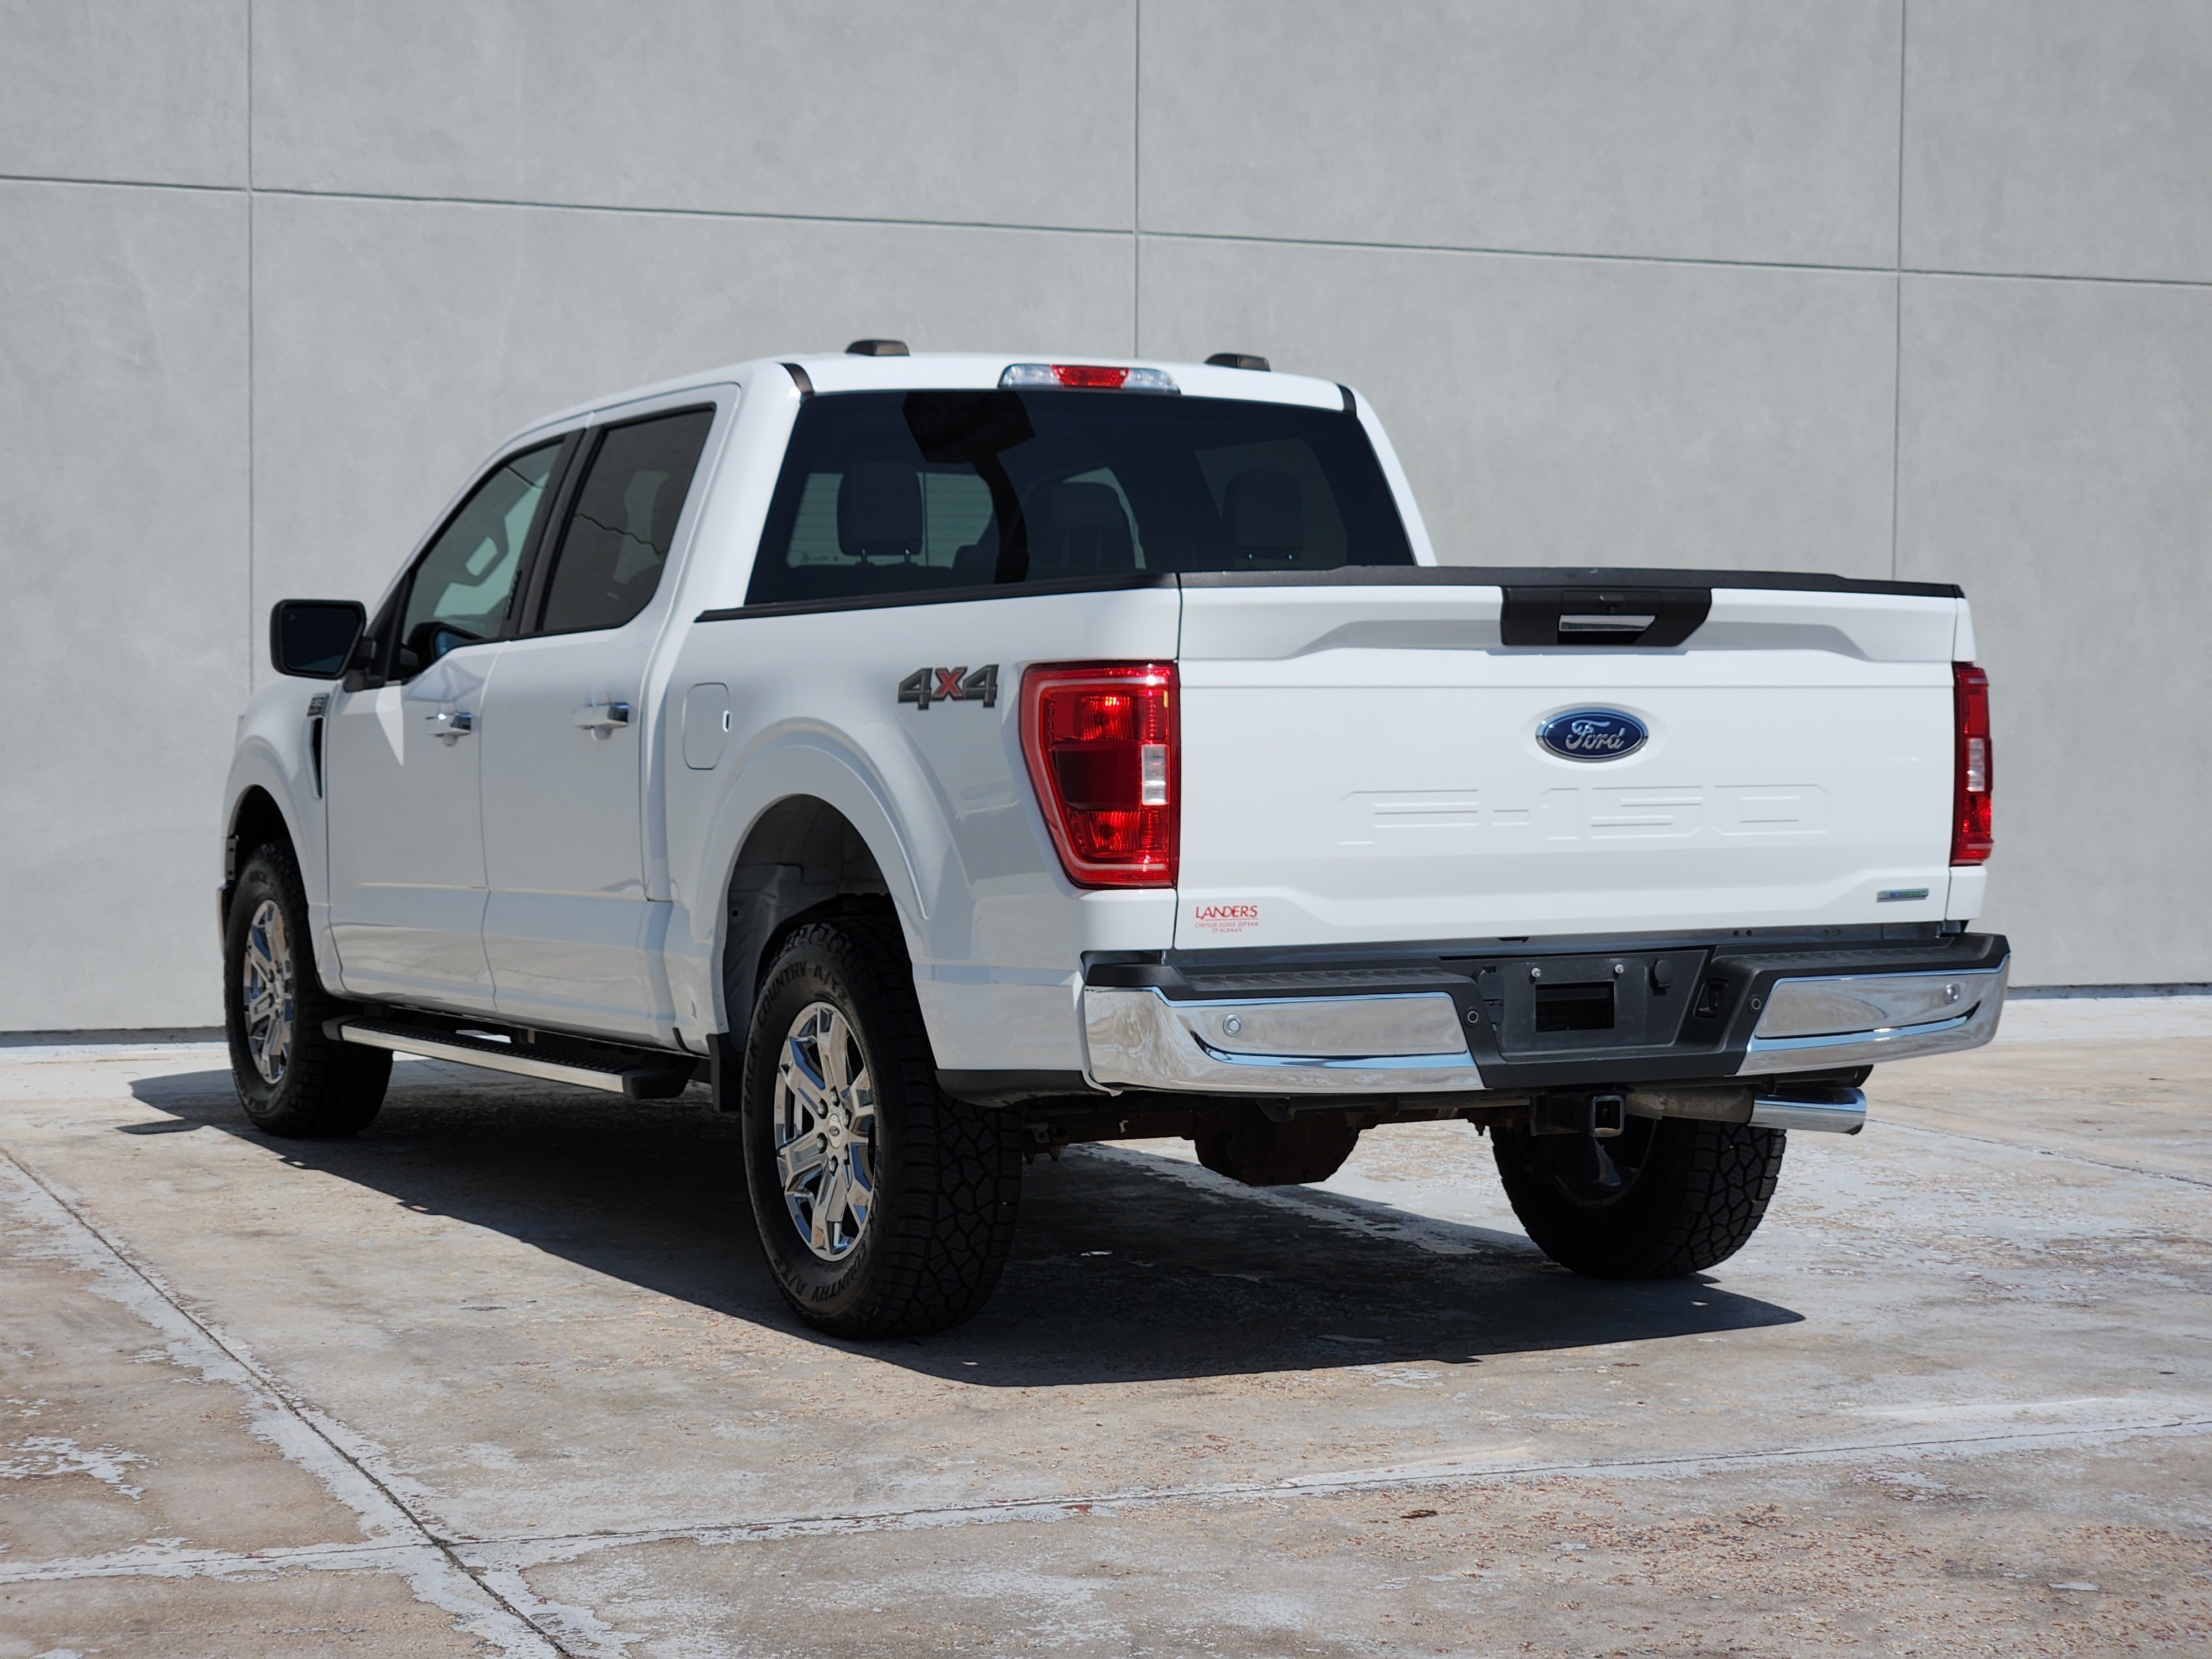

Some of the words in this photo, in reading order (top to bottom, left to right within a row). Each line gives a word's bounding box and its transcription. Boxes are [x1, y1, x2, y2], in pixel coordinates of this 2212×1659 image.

[898, 664, 999, 710] 4X4
[1566, 720, 1625, 750] Ford
[1196, 905, 1258, 919] LANDERS
[757, 961, 807, 1027] COUNTRY
